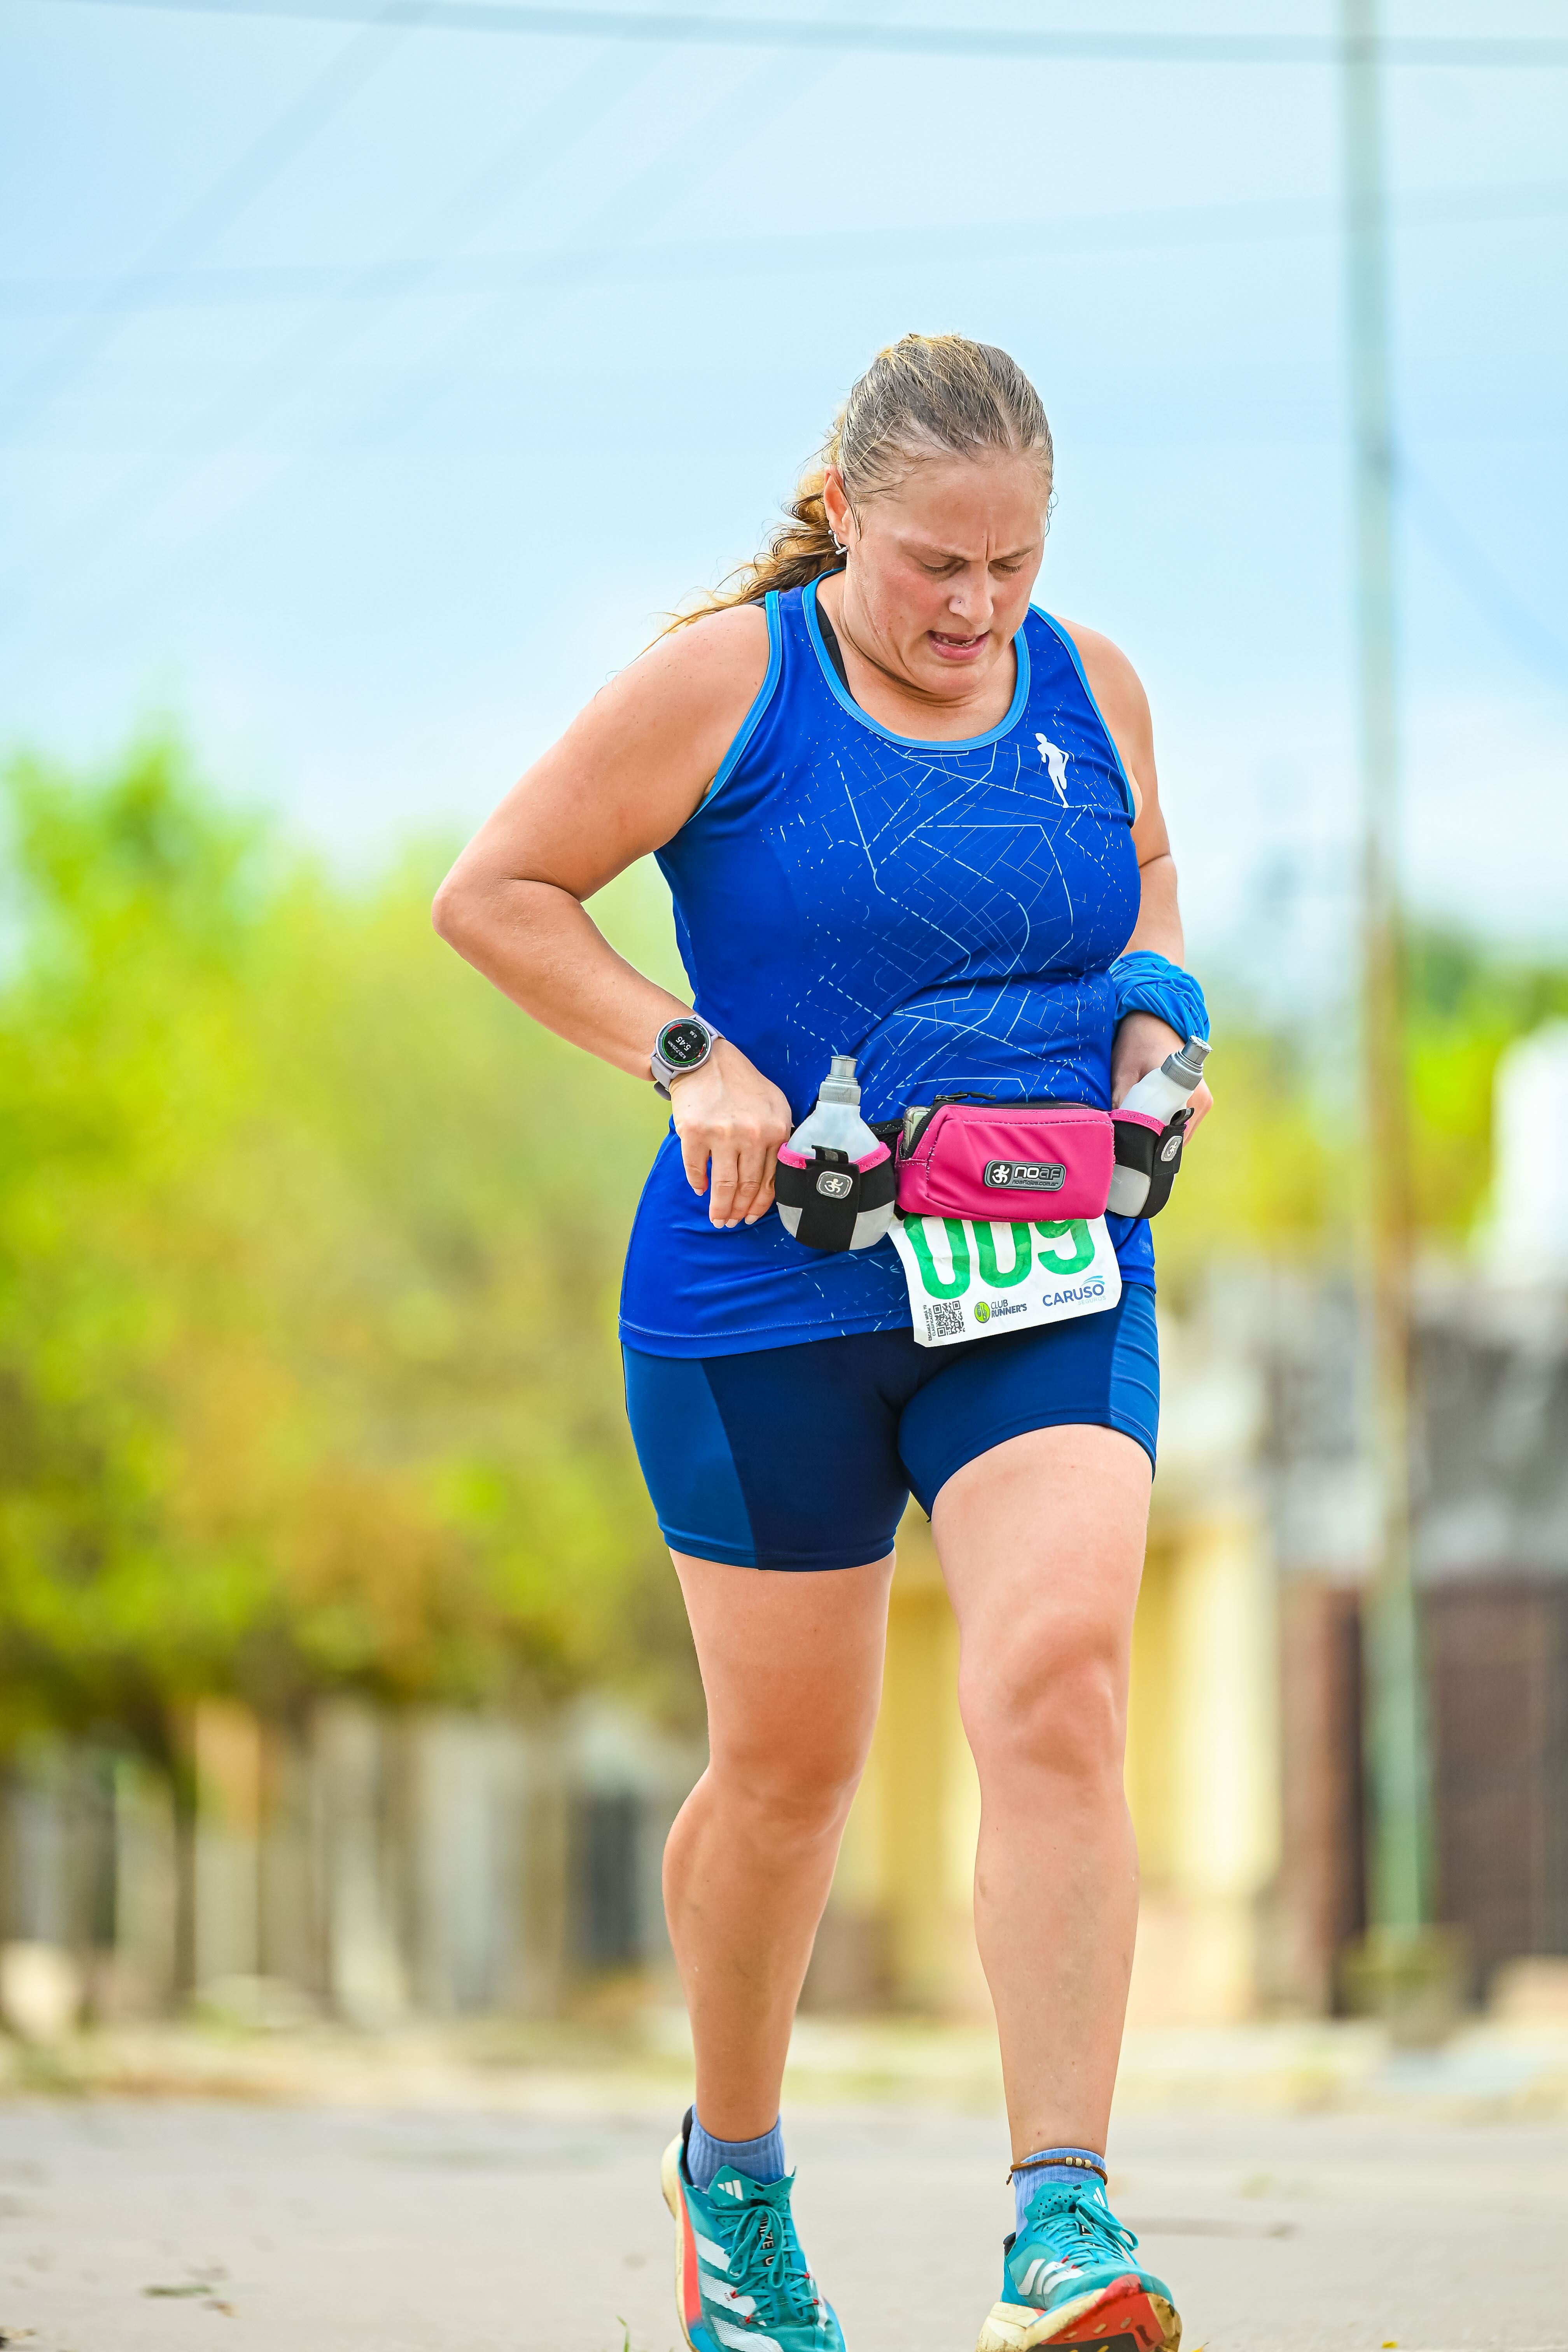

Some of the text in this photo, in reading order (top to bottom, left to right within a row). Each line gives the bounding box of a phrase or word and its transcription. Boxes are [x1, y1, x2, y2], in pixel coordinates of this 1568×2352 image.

[676, 1036, 691, 1051] 5:45
[903, 1212, 1095, 1299] 009
[1043, 1284, 1104, 1306] CARUSO
[1078, 1295, 1106, 1305] SEGUROS
[991, 1299, 1008, 1309] CLUB
[991, 1304, 1027, 1318] RUNNER'S
